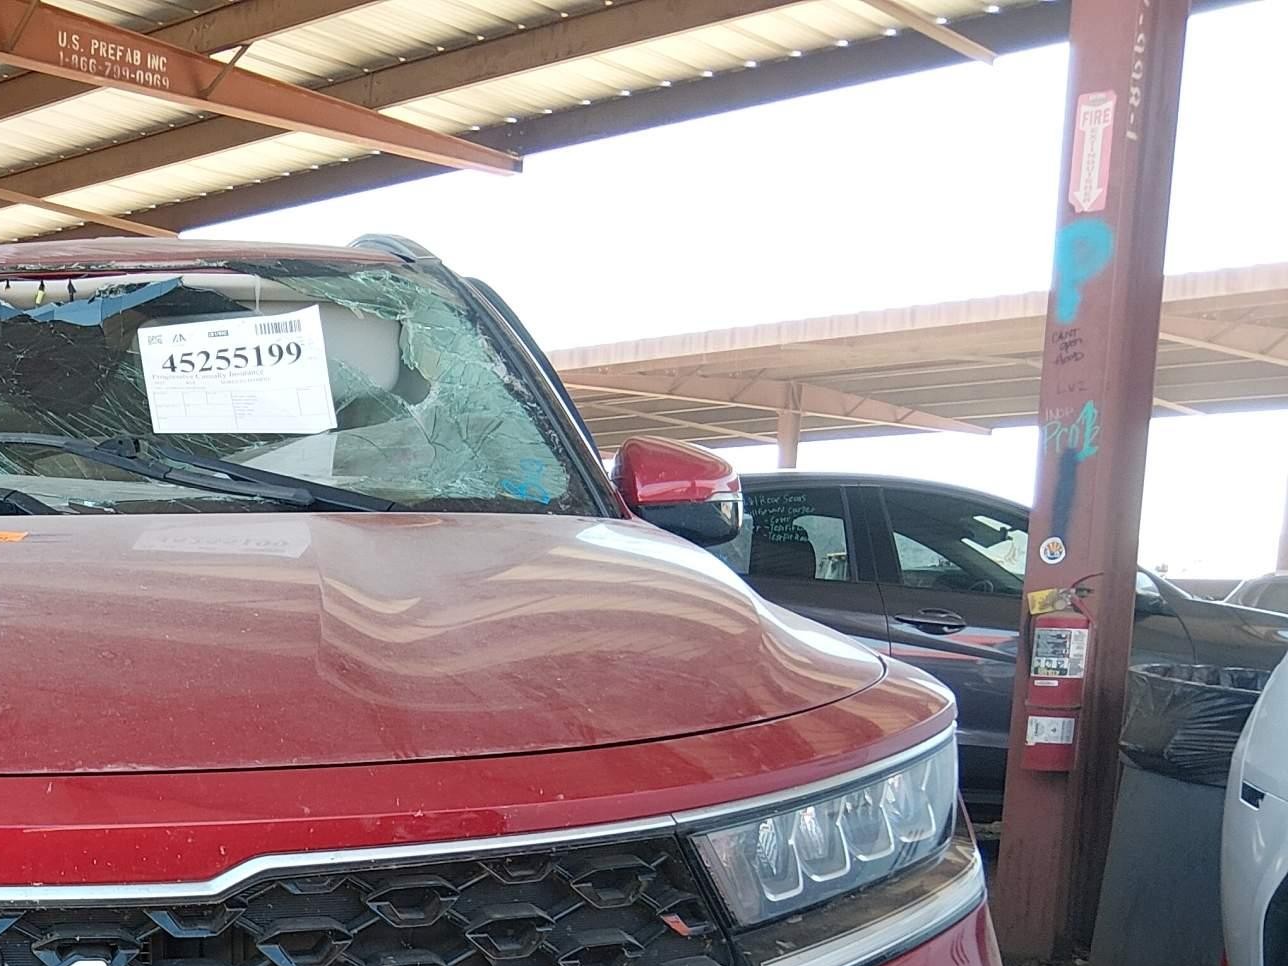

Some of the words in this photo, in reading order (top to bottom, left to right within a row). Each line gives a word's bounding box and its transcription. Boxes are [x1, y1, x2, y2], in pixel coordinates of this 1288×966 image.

[58, 30, 84, 52] U.S.
[91, 39, 141, 66] PREFAB
[1081, 107, 1111, 128] FIRE
[162, 341, 302, 373] 45255199
